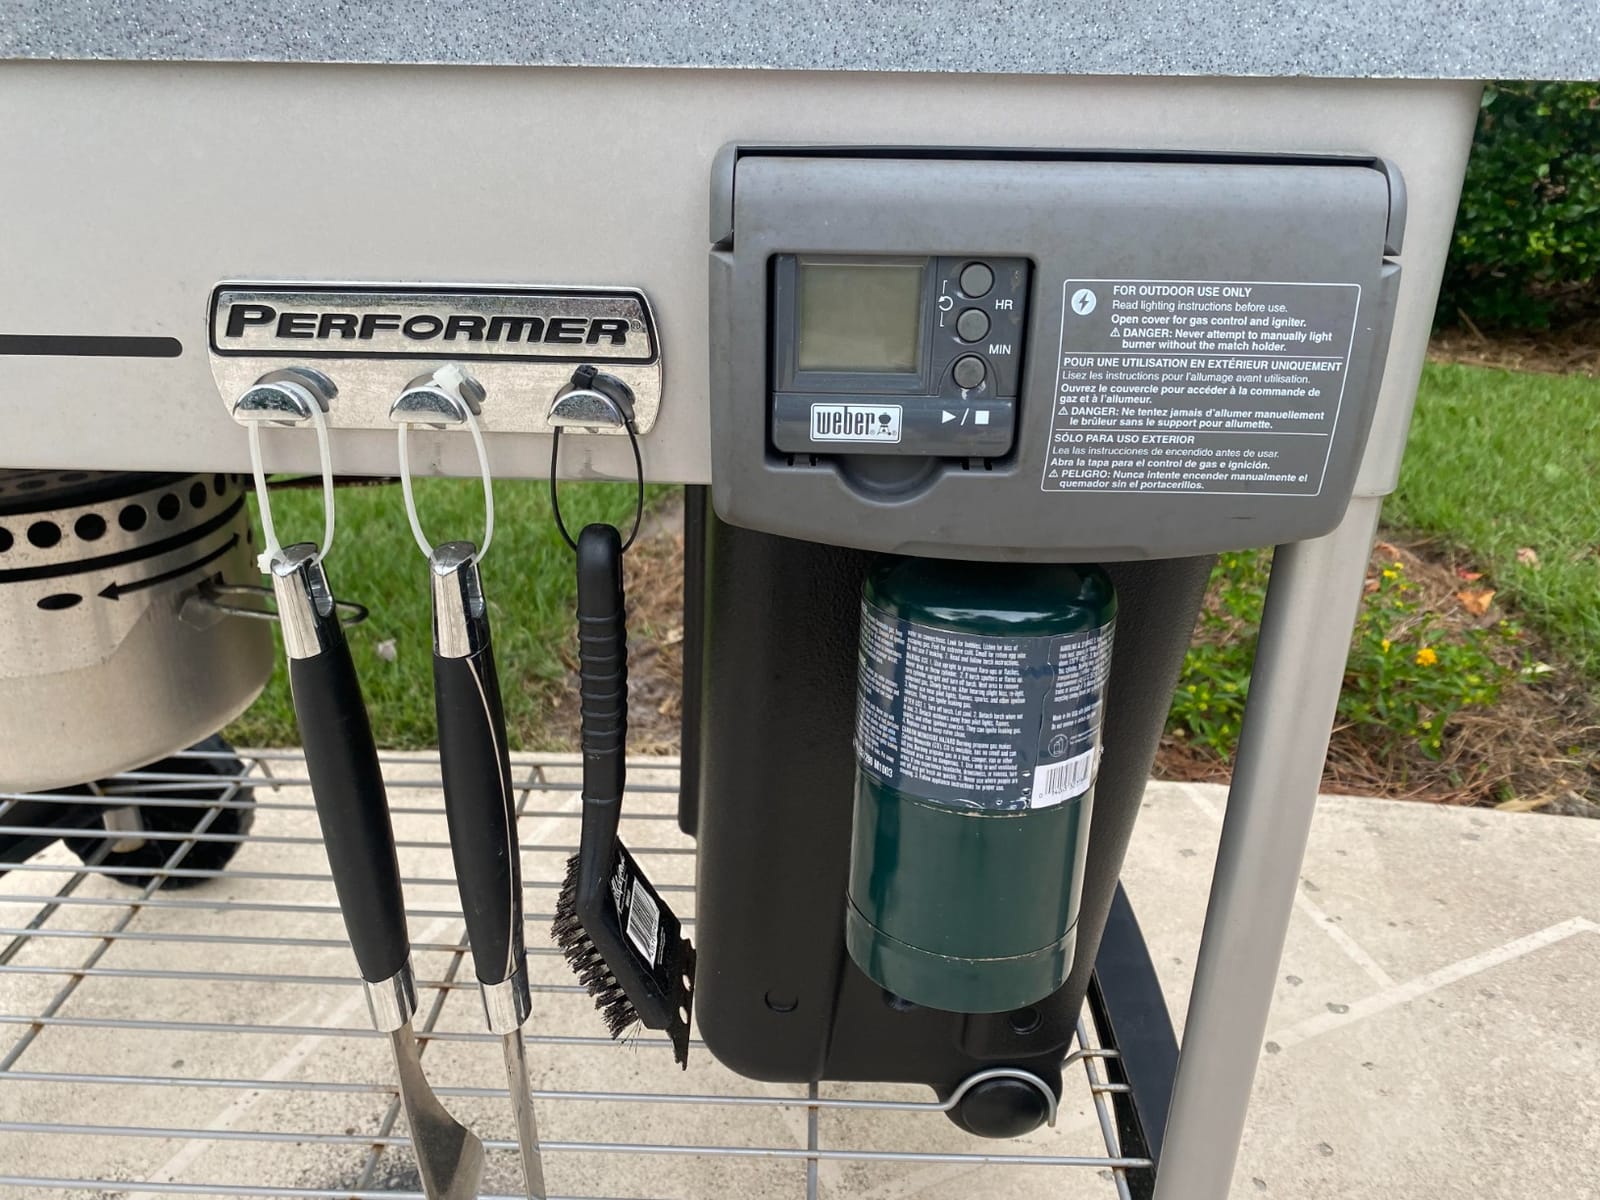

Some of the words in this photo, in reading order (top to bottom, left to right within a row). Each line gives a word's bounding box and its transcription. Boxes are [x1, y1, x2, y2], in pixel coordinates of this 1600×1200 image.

[1113, 285, 1136, 295] FOR
[1139, 285, 1194, 296] OUTDOOR
[1197, 286, 1219, 296] USE
[1222, 287, 1252, 297] ONLY
[995, 299, 1013, 310] HR
[1112, 299, 1138, 309] Read
[1140, 300, 1175, 312] lighting
[1177, 300, 1232, 311] instructions
[1234, 301, 1265, 312] before
[1267, 304, 1287, 312] use.
[226, 304, 630, 346] PERFORMER
[1111, 313, 1139, 326] Open
[1141, 316, 1170, 324] cover
[1172, 314, 1187, 324] for
[1189, 317, 1208, 327] gas
[1210, 316, 1247, 325] control
[1249, 316, 1269, 326] and
[1271, 316, 1306, 328] igniter.
[1123, 327, 1172, 338] DANGER:
[1174, 328, 1204, 338] Never
[1206, 329, 1245, 341] attempt
[1247, 330, 1258, 340] to
[1260, 331, 1307, 343] manually
[1309, 331, 1332, 343] light
[989, 344, 1011, 354] MIN
[1121, 338, 1156, 349] burner
[1158, 339, 1197, 349] without
[1198, 340, 1215, 350] the
[1217, 341, 1249, 350] match
[1251, 341, 1286, 351] holder.
[1063, 357, 1094, 367] POUR
[1097, 357, 1120, 367] UNE
[1122, 357, 1188, 368] UTILISATION
[1190, 358, 1205, 368] EN
[1207, 357, 1269, 369] EXTÉRIEUR
[1271, 360, 1343, 371] UNIQUEMENT
[1062, 370, 1087, 379] Lisez
[1089, 370, 1103, 380] les
[1105, 370, 1159, 380] instructions
[1161, 373, 1183, 382] pour
[1185, 372, 1233, 384] l'allumage
[1235, 374, 1262, 382] avant
[1264, 373, 1310, 383] utilisation.
[1060, 383, 1096, 392] Ouvrez
[1098, 383, 1107, 392] le
[1110, 384, 1159, 393] couvercle
[1160, 386, 1185, 395] pour
[1186, 385, 1228, 395] accéder
[1229, 385, 1236, 395] à
[1238, 386, 1248, 395] la
[1249, 387, 1306, 396] commande
[1307, 387, 1320, 396] de
[1059, 395, 1077, 404] gaz
[1079, 394, 1089, 403] et
[1091, 393, 1098, 403] à
[1100, 394, 1152, 403] l'allumeur.
[1071, 406, 1119, 416] DANGER:
[1121, 407, 1135, 416] Ne
[1137, 407, 1168, 418] tentez
[1169, 407, 1202, 418] jamais
[1205, 408, 1253, 418] d'allumer
[1254, 410, 1325, 420] manuellement
[816, 406, 875, 435] weber
[1069, 416, 1079, 425] le
[1081, 416, 1117, 425] brûleur
[1146, 417, 1155, 426] le
[1157, 417, 1197, 428] support
[1198, 420, 1223, 429] pour
[1224, 419, 1273, 429] allumette.
[1054, 431, 1083, 442] SÓLO
[1085, 434, 1114, 443] PARA
[1116, 434, 1139, 443] USO
[1141, 434, 1195, 444] EXTERIOR
[1052, 446, 1069, 454] Lea
[1072, 446, 1086, 454] las
[1088, 446, 1148, 455] instrucciones
[1151, 447, 1163, 455] de
[1165, 447, 1213, 456] encendido
[1215, 448, 1241, 457] antes
[1243, 448, 1255, 457] de
[1257, 450, 1279, 458] usar.
[1050, 457, 1074, 466] Abra
[1076, 457, 1085, 466] la
[1087, 458, 1109, 468] tapa
[1111, 460, 1133, 468] para
[1135, 458, 1145, 467] el
[1147, 459, 1182, 467] control
[1184, 459, 1197, 467] de
[1198, 461, 1217, 470] gas
[1228, 460, 1270, 471] ignición.
[1061, 469, 1110, 478] PELIGRO:
[1112, 470, 1144, 478] Nunca
[1146, 470, 1180, 479] intente
[1182, 471, 1229, 480] encender
[1230, 472, 1296, 482] manualmente
[1298, 473, 1308, 482] el
[1059, 479, 1109, 488] quemador
[1112, 479, 1126, 487] sin
[1140, 481, 1204, 489] portacerillos.
